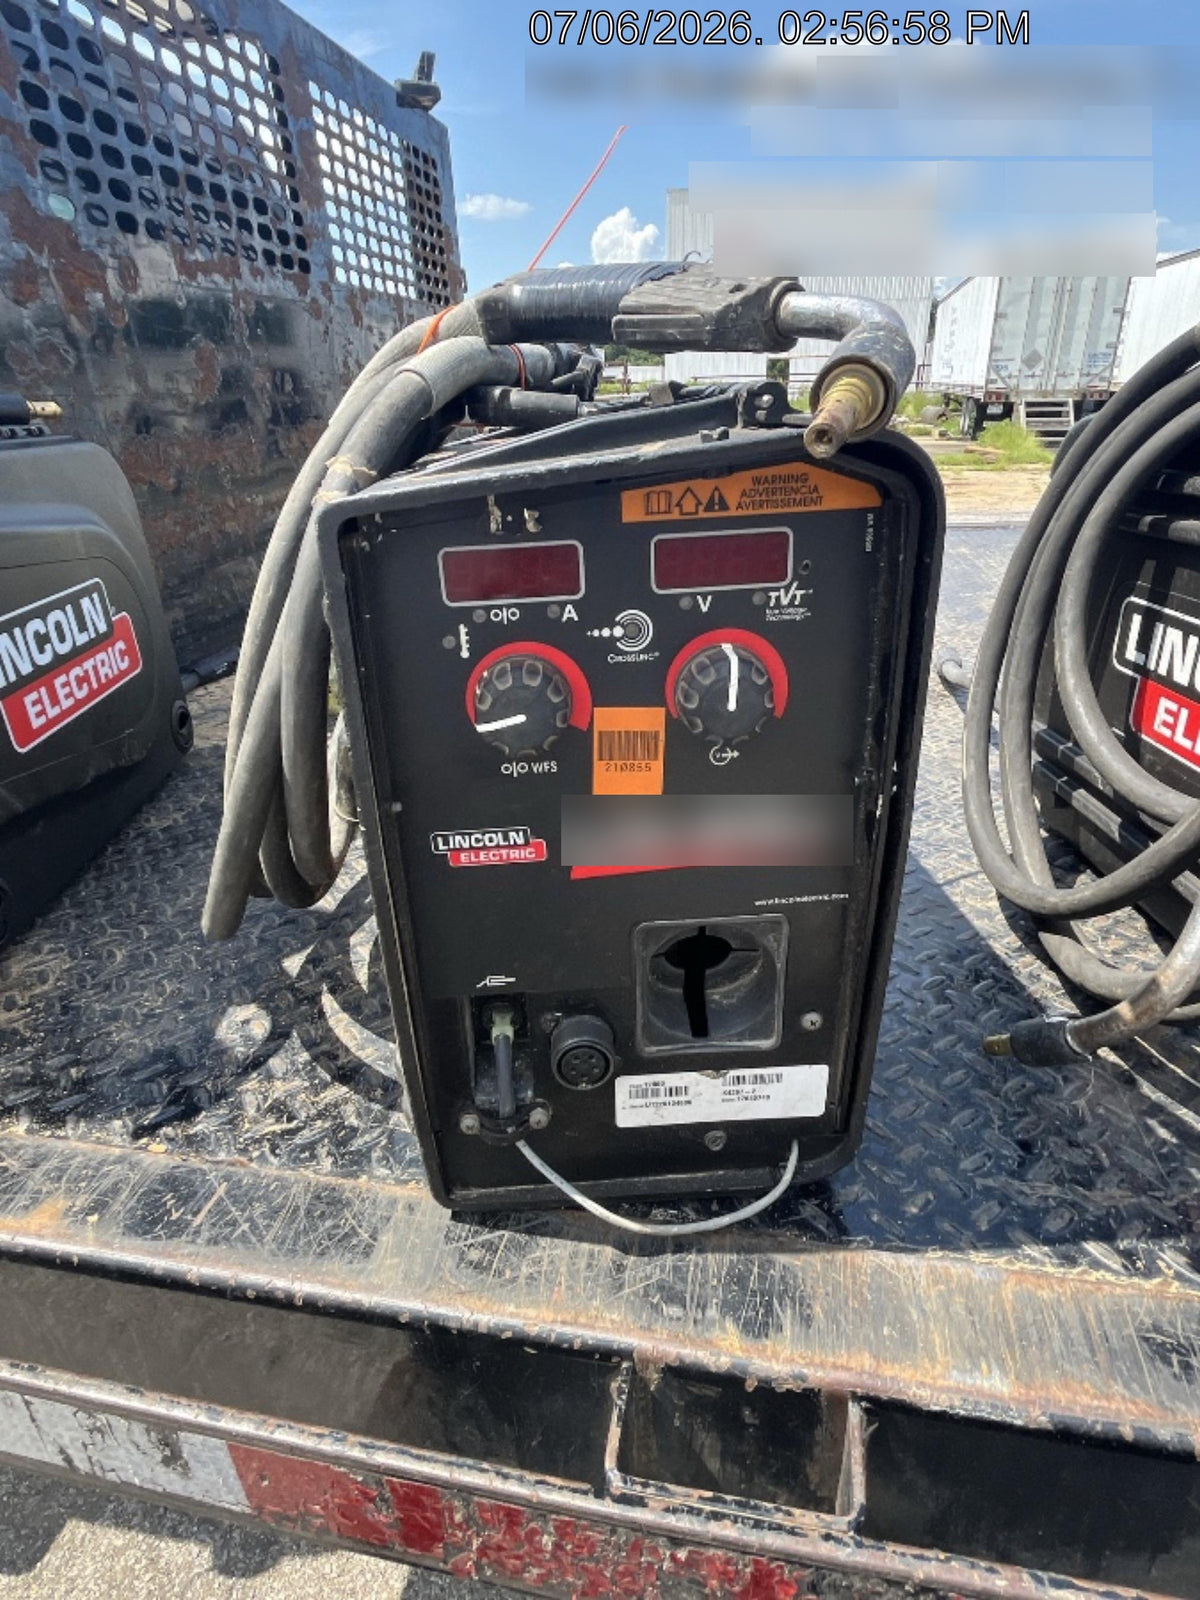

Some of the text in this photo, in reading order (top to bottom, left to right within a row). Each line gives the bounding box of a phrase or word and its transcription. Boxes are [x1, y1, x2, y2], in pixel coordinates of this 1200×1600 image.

[752, 472, 809, 486] WARNING
[740, 484, 820, 499] ADVERTENCIA
[736, 495, 823, 511] AVERTISSEMENT
[561, 603, 579, 623] A
[697, 594, 712, 613] V
[0, 592, 108, 689] NCOLN
[1125, 612, 1200, 693] LIN
[24, 639, 130, 730] ELECTRIC
[1153, 696, 1200, 757] EL
[530, 760, 558, 774] WFS
[605, 762, 652, 773] 210855
[437, 831, 525, 850] LINCOLN
[460, 847, 536, 863] ELECTRIC
